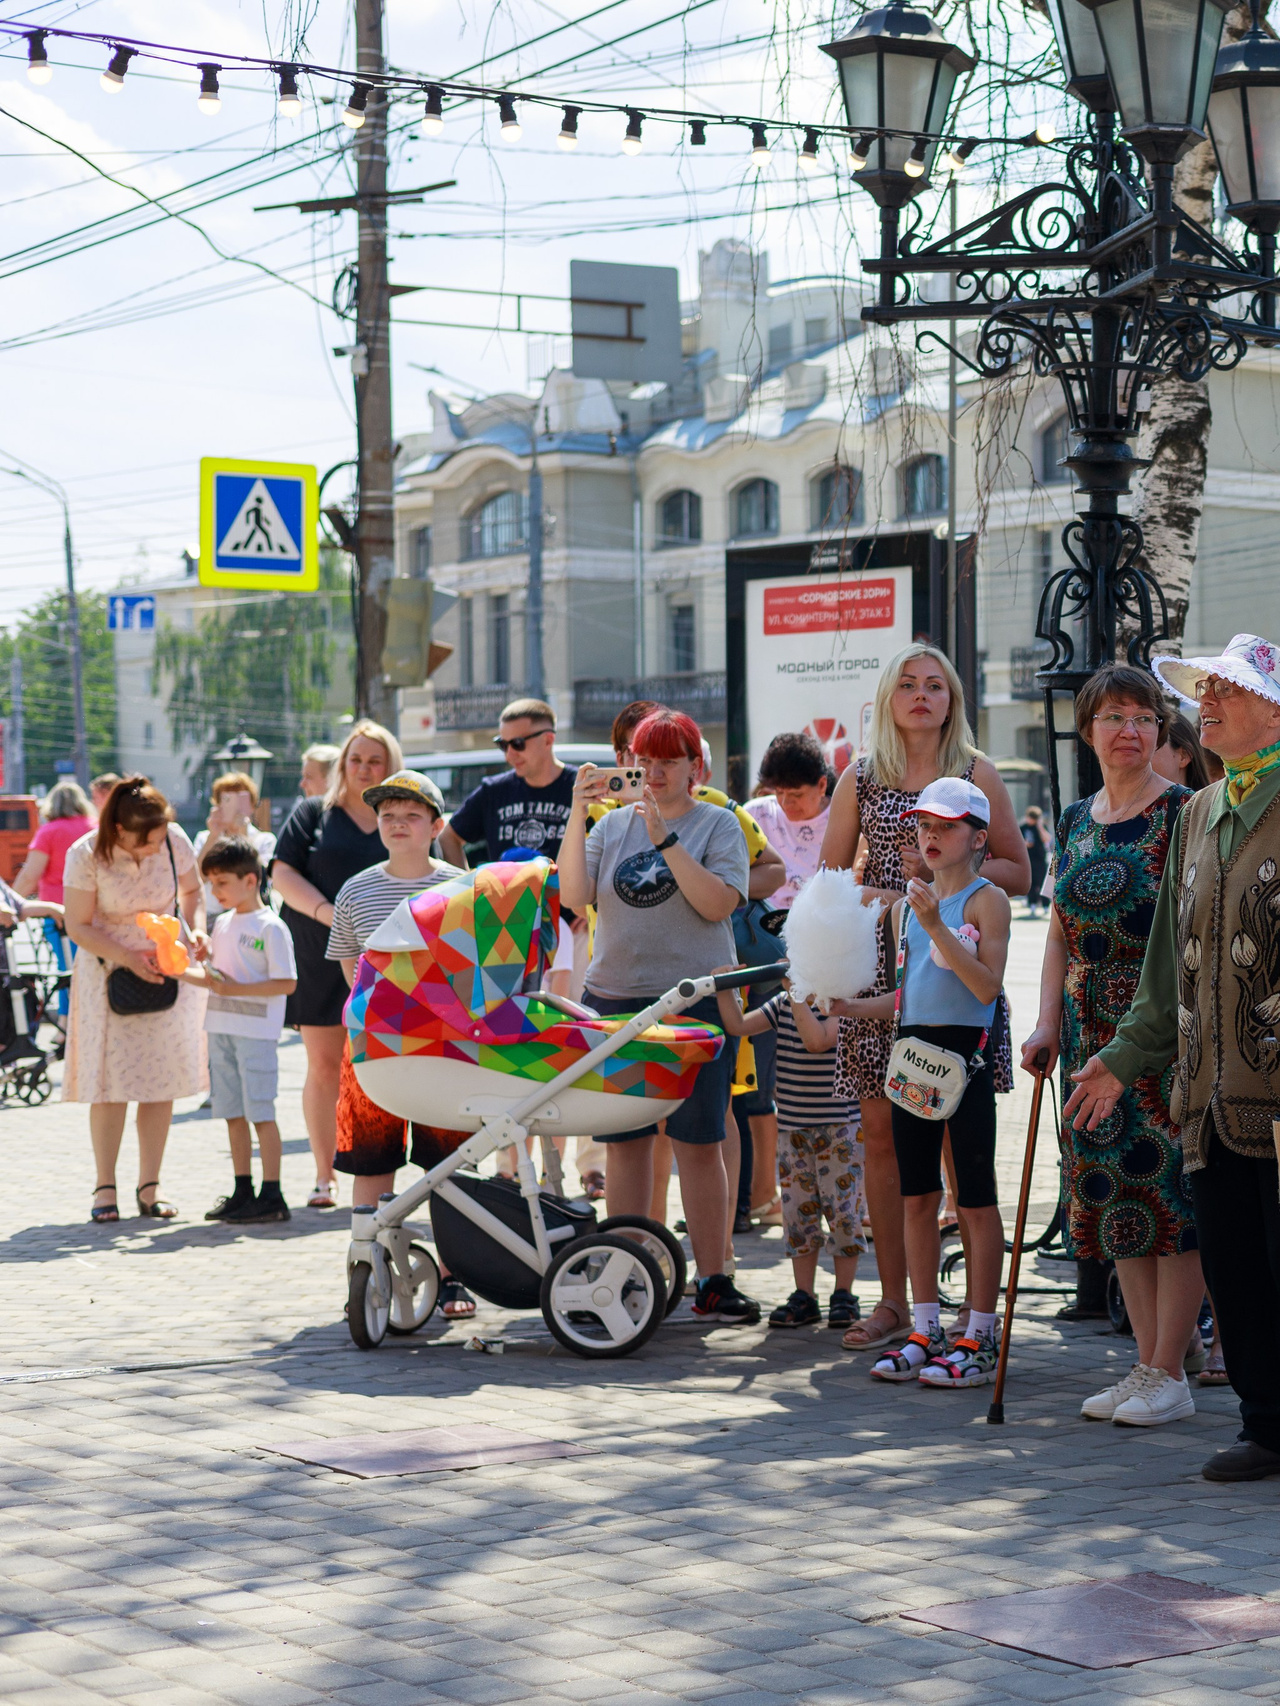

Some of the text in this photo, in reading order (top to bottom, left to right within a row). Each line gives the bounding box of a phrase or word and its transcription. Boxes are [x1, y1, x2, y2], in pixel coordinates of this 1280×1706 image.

[863, 586, 891, 599] ЗОРИ»
[767, 615, 781, 625] УЛ.
[860, 607, 883, 620] ЭТАЖ
[885, 607, 891, 618] 3
[777, 658, 880, 673] МОДНЫЙ ГОРОД
[497, 802, 524, 820] TOM
[620, 882, 672, 901] NEW FASHION
